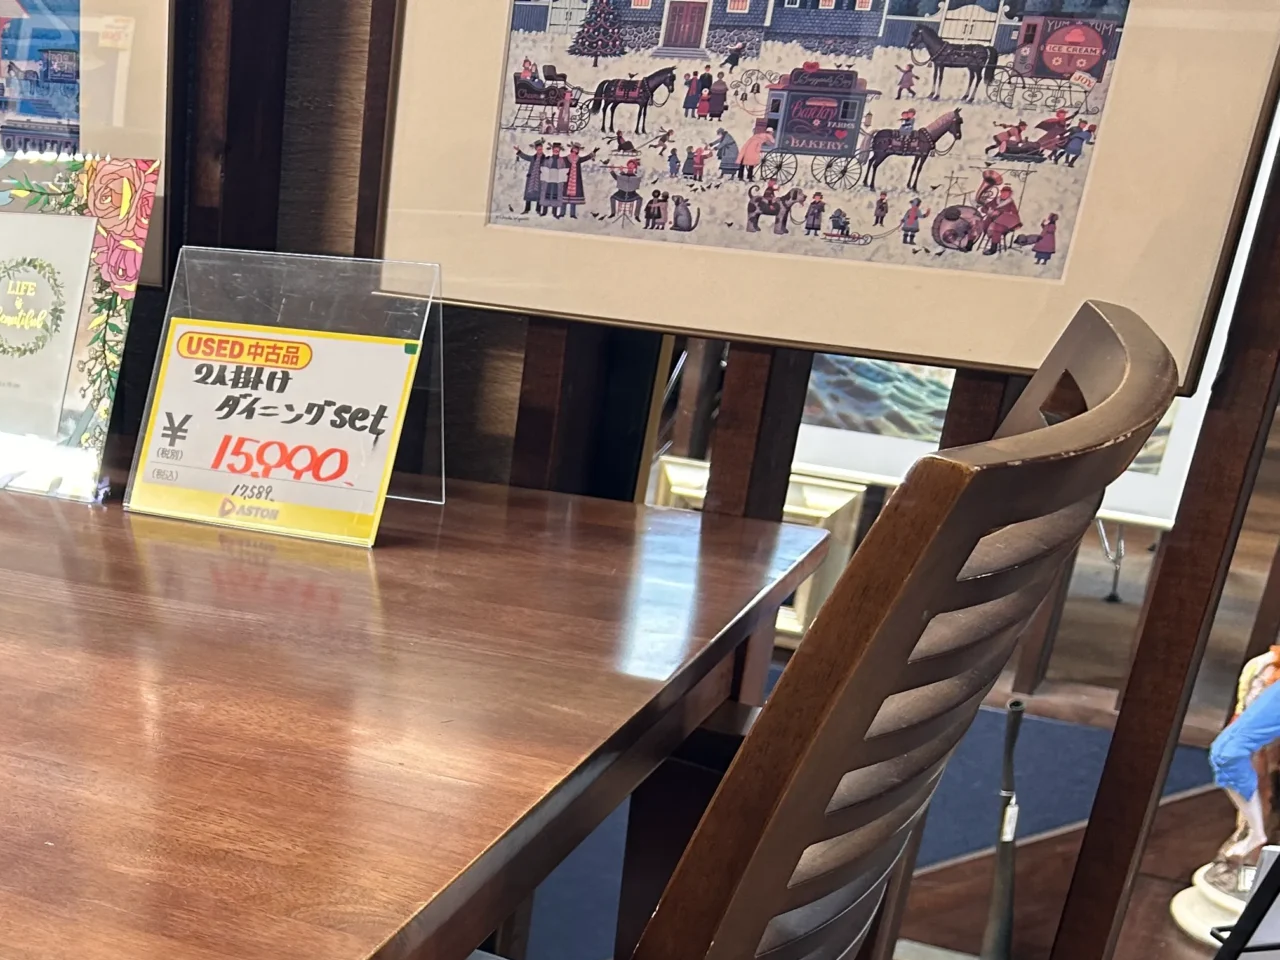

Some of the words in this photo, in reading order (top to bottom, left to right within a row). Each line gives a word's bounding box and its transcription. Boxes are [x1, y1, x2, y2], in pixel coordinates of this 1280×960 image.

[1047, 20, 1070, 32] YUM
[1066, 46, 1097, 55] CREAM
[1073, 74, 1094, 88] JOY
[827, 121, 856, 130] FARMS
[790, 137, 845, 150] BAKERY
[7, 280, 37, 296] LIFE
[187, 336, 245, 359] USED
[247, 341, 300, 366] 中古品
[193, 363, 293, 394] 2人掛け
